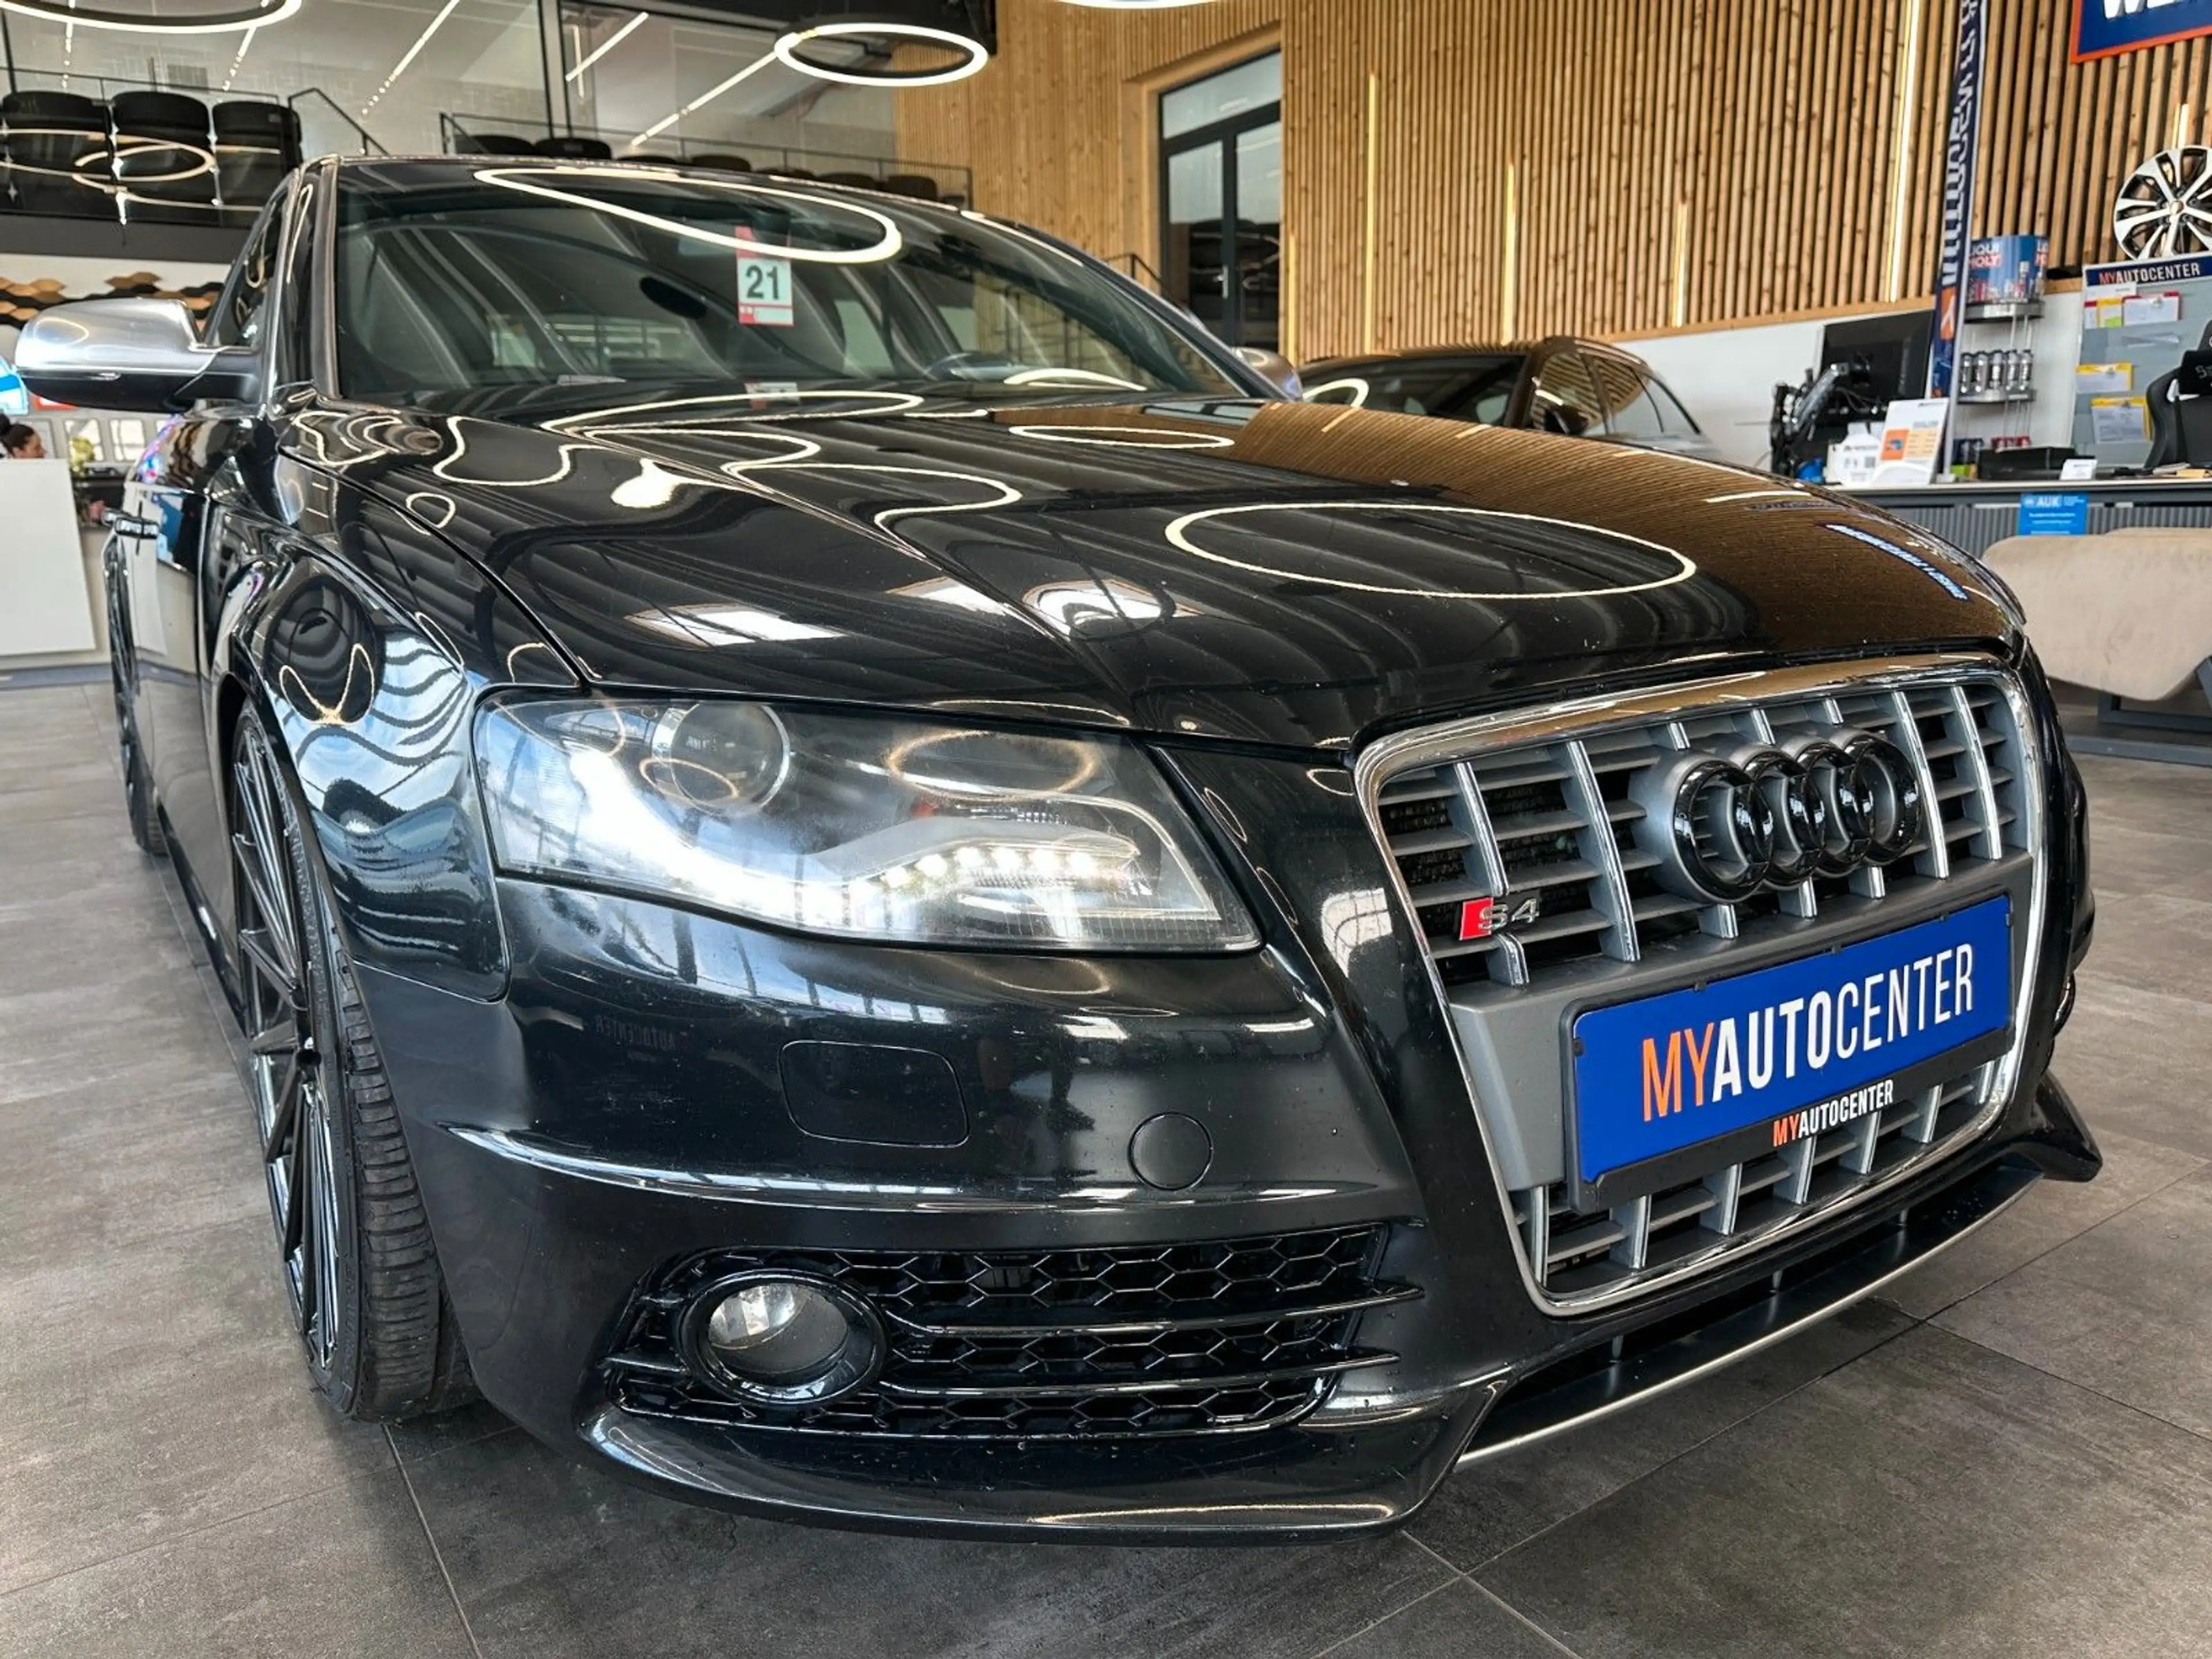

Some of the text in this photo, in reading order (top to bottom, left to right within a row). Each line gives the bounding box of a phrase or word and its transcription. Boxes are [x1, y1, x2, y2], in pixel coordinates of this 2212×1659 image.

[745, 265, 779, 300] 21
[2099, 263, 2200, 284] MYAUTOCENTER
[1478, 897, 1540, 931] S4
[1642, 943, 1974, 1122] MYAUTOCENTER
[1772, 1079, 1894, 1147] MYAUTOCENTER
